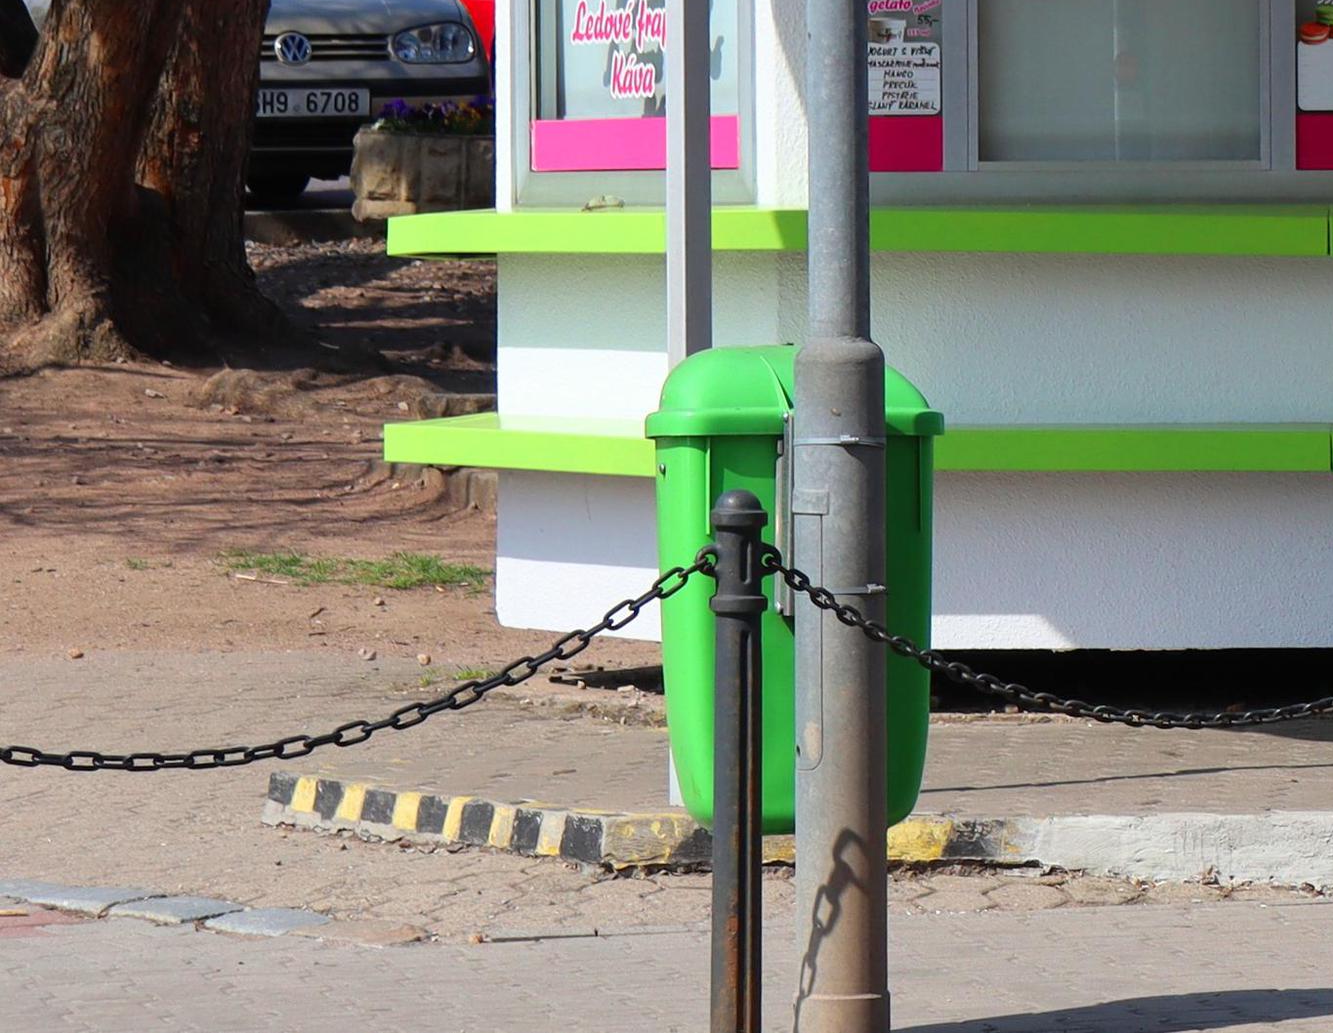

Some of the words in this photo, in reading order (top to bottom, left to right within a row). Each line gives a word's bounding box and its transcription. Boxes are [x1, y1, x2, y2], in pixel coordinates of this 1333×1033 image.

[573, 0, 633, 41] Ledové
[612, 54, 654, 94] Káva
[306, 91, 359, 113] 6708
